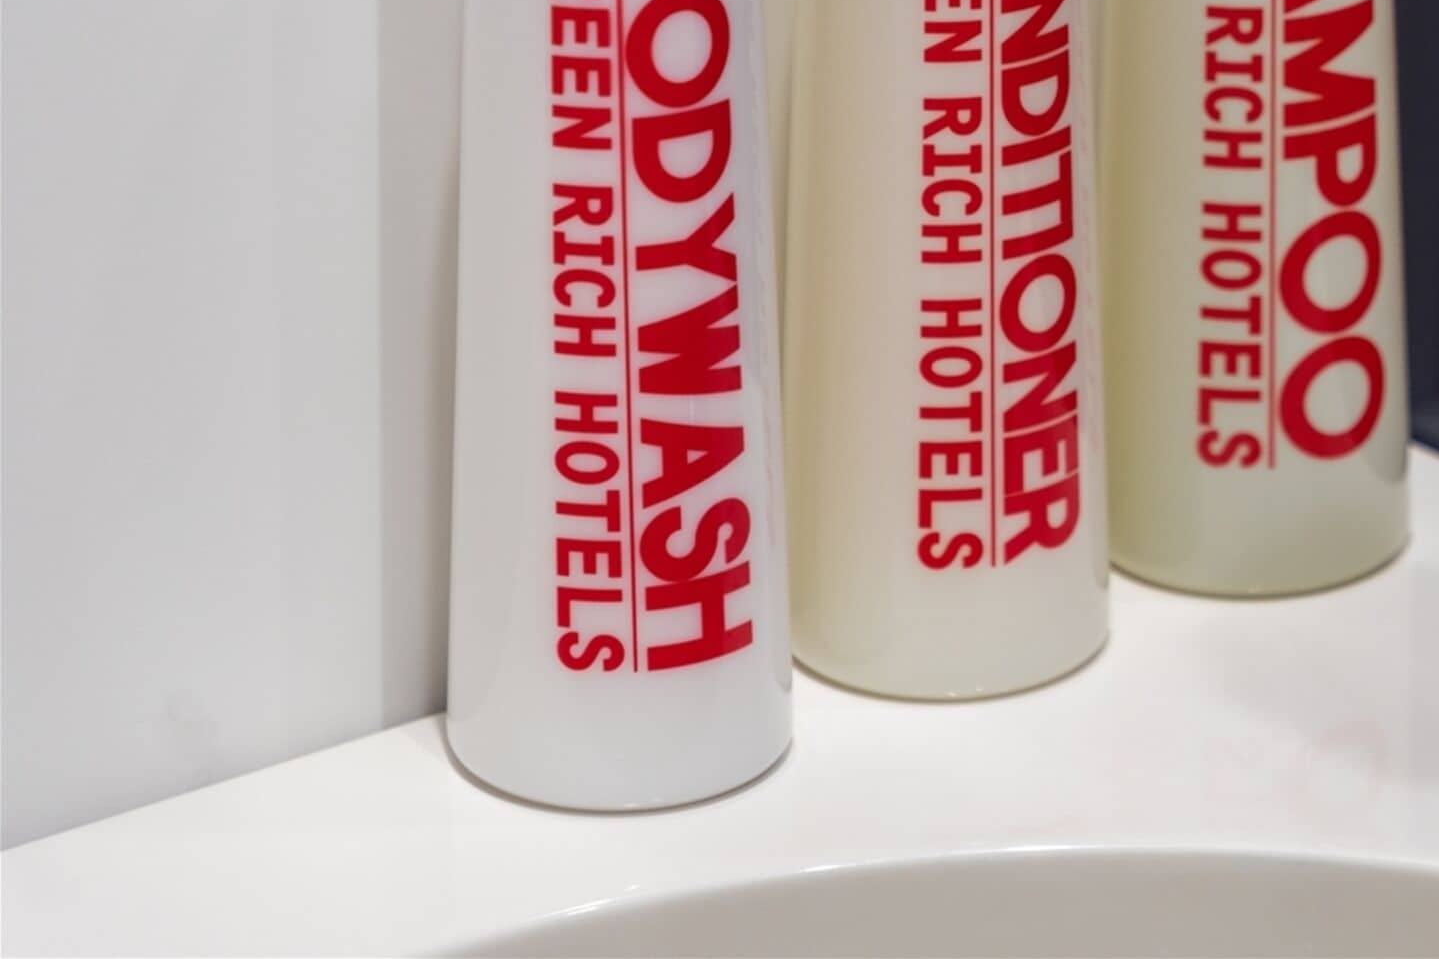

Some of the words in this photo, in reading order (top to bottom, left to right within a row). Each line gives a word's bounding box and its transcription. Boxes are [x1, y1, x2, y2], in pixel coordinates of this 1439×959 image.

[919, 95, 984, 266] RICH
[1202, 5, 1266, 171] RICH
[551, 182, 617, 359] RICH
[1196, 201, 1265, 469] HOTELS
[553, 390, 625, 673] HOTELS
[916, 297, 982, 573] HOTELS
